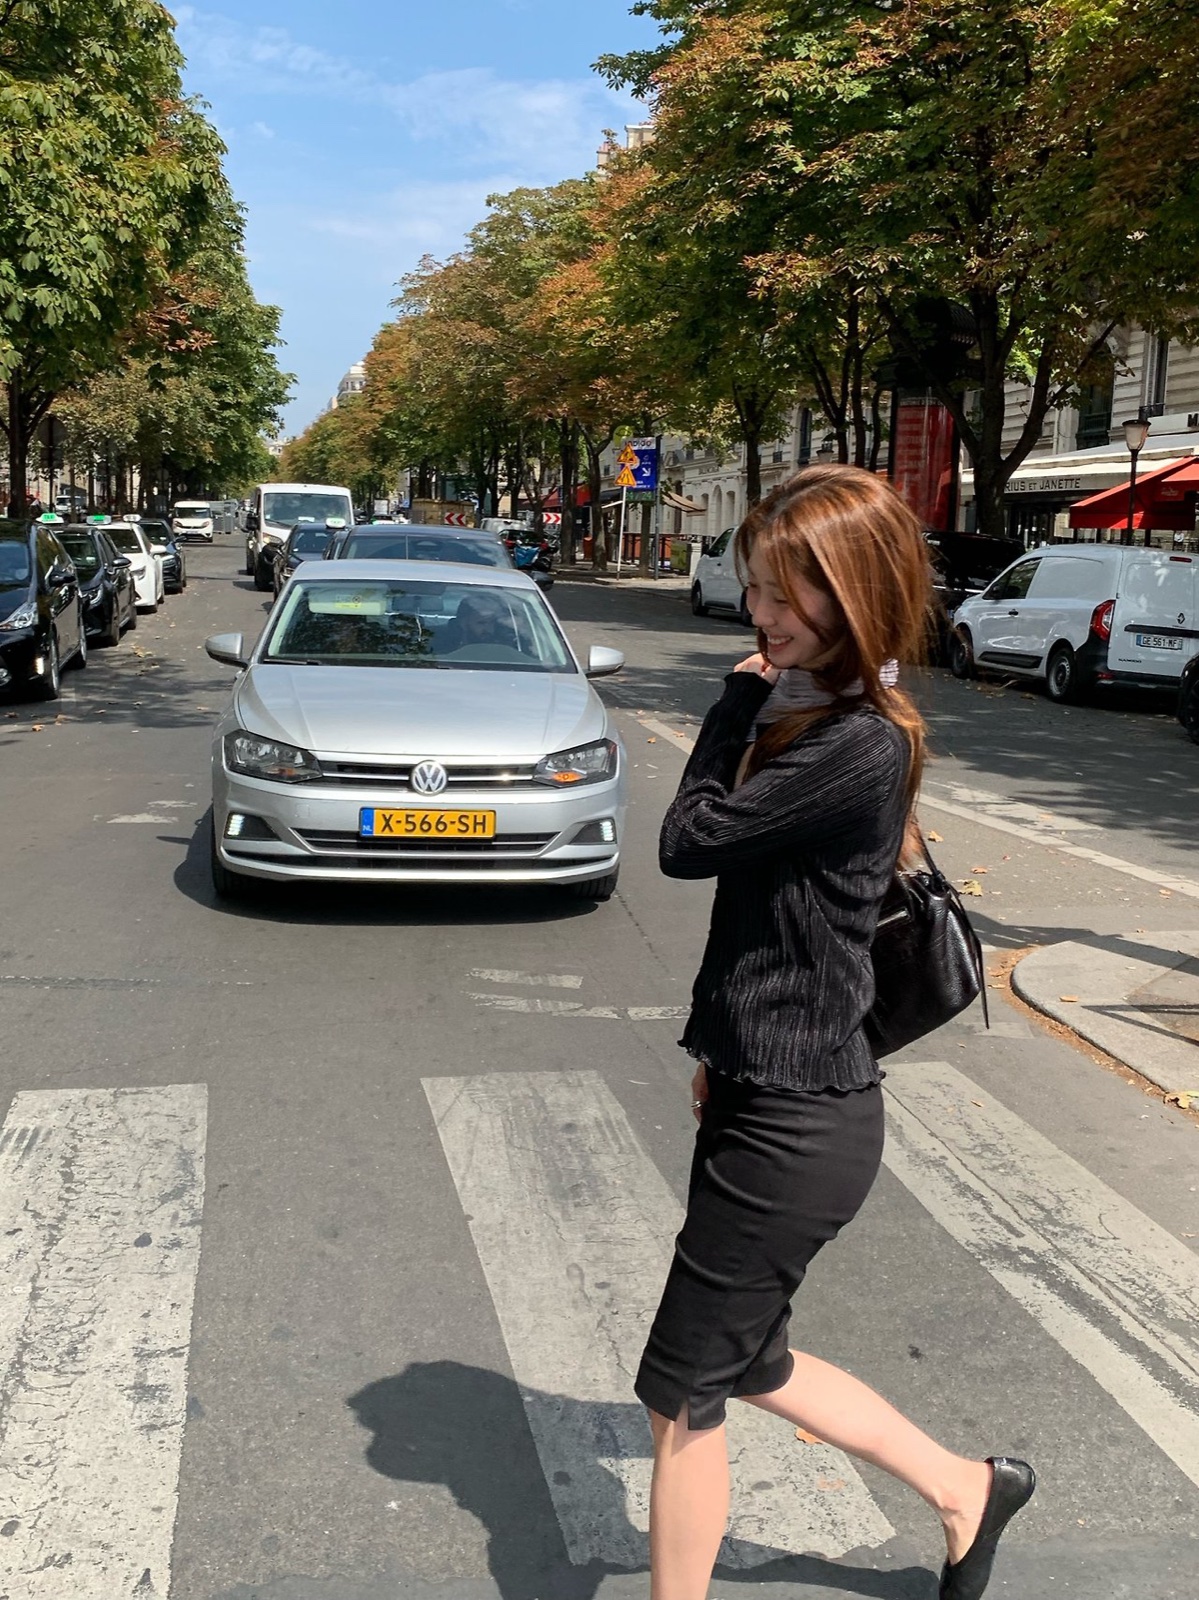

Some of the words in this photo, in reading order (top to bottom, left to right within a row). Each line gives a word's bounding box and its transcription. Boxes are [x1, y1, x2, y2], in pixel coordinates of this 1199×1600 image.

[1028, 482, 1037, 491] ET
[1039, 478, 1081, 490] JANETTE
[381, 813, 486, 833] X-566-SH
